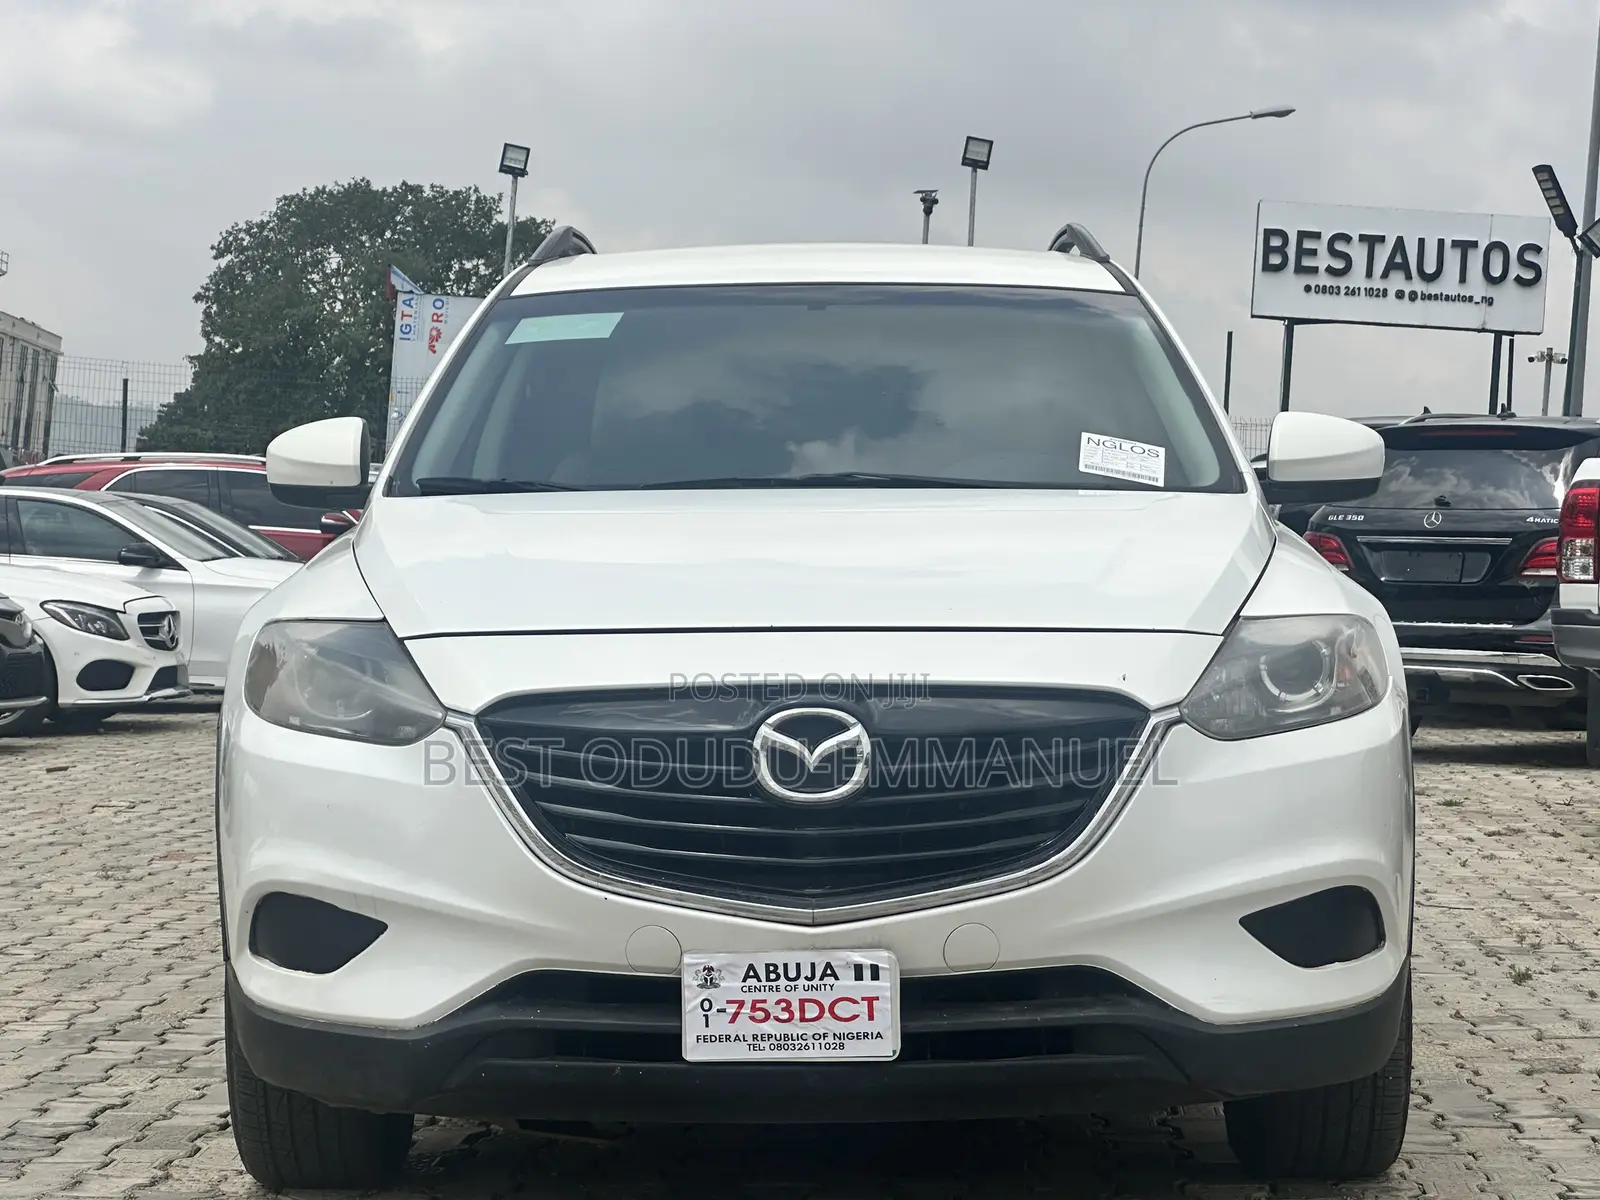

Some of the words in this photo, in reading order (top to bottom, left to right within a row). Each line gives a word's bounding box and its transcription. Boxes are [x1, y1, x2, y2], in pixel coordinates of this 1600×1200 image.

[1261, 227, 1543, 287] BESTAUTOS
[1314, 284, 1340, 295] 0803
[1344, 286, 1361, 297] 261
[1364, 287, 1388, 298] 1028
[1087, 437, 1160, 458] NGLOS
[1526, 516, 1559, 524] 4MATIC
[741, 961, 840, 983] ABUJA
[740, 984, 781, 993] CENTRE
[784, 984, 800, 993] OF
[802, 983, 836, 992] UNITY
[696, 1034, 748, 1044] FEDERAL
[752, 1033, 808, 1043] REPUBLIC
[812, 1032, 829, 1041] OF
[833, 1031, 884, 1041] NIGERIA
[747, 1043, 766, 1052] TEL:
[769, 1042, 845, 1052] 08032611028
